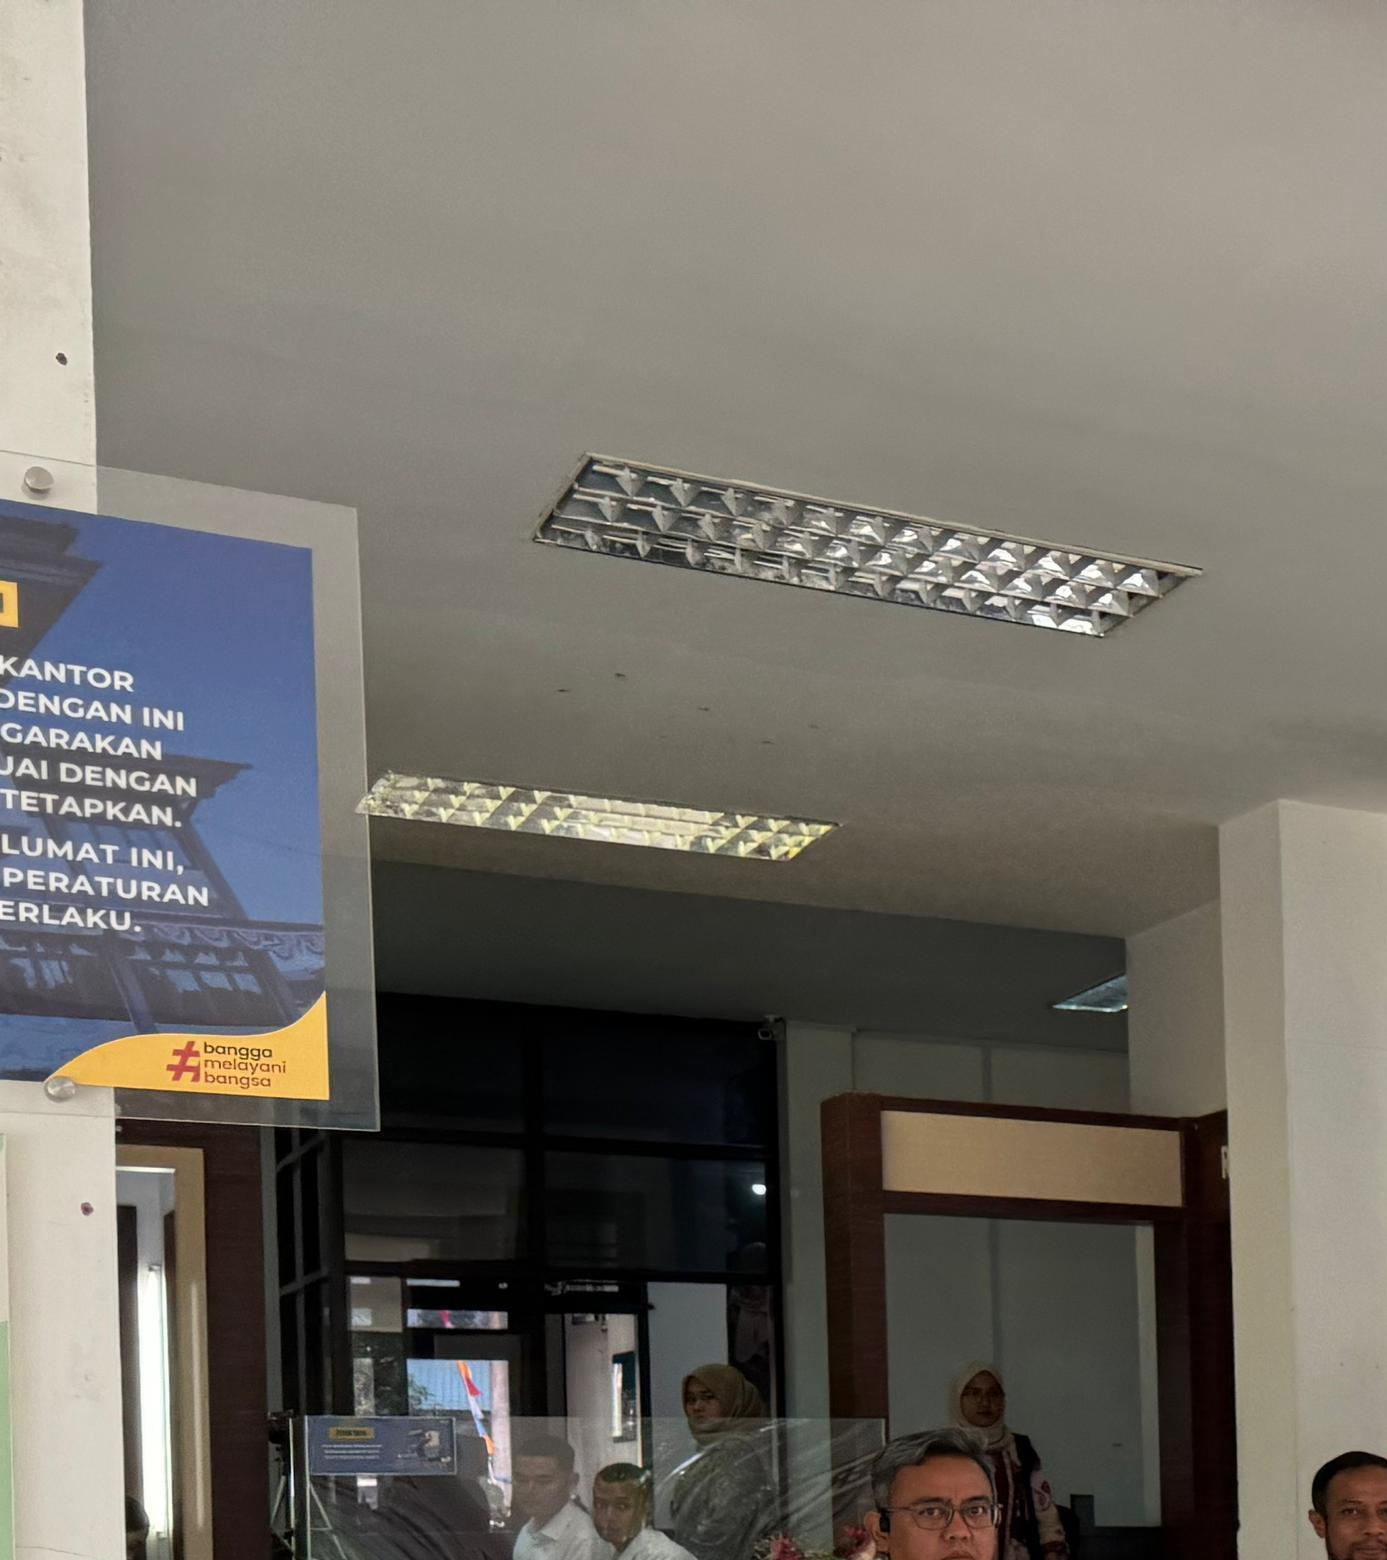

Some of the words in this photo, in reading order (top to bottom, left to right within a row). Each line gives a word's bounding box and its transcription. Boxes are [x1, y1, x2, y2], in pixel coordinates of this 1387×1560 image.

[142, 706, 184, 732] INI
[59, 762, 197, 798] DENGAN
[131, 847, 184, 876] INI,
[3, 867, 209, 907] PERATURAN
[204, 1041, 273, 1061] bangga
[204, 1058, 287, 1076] melayani
[204, 1071, 271, 1090] bangsa
